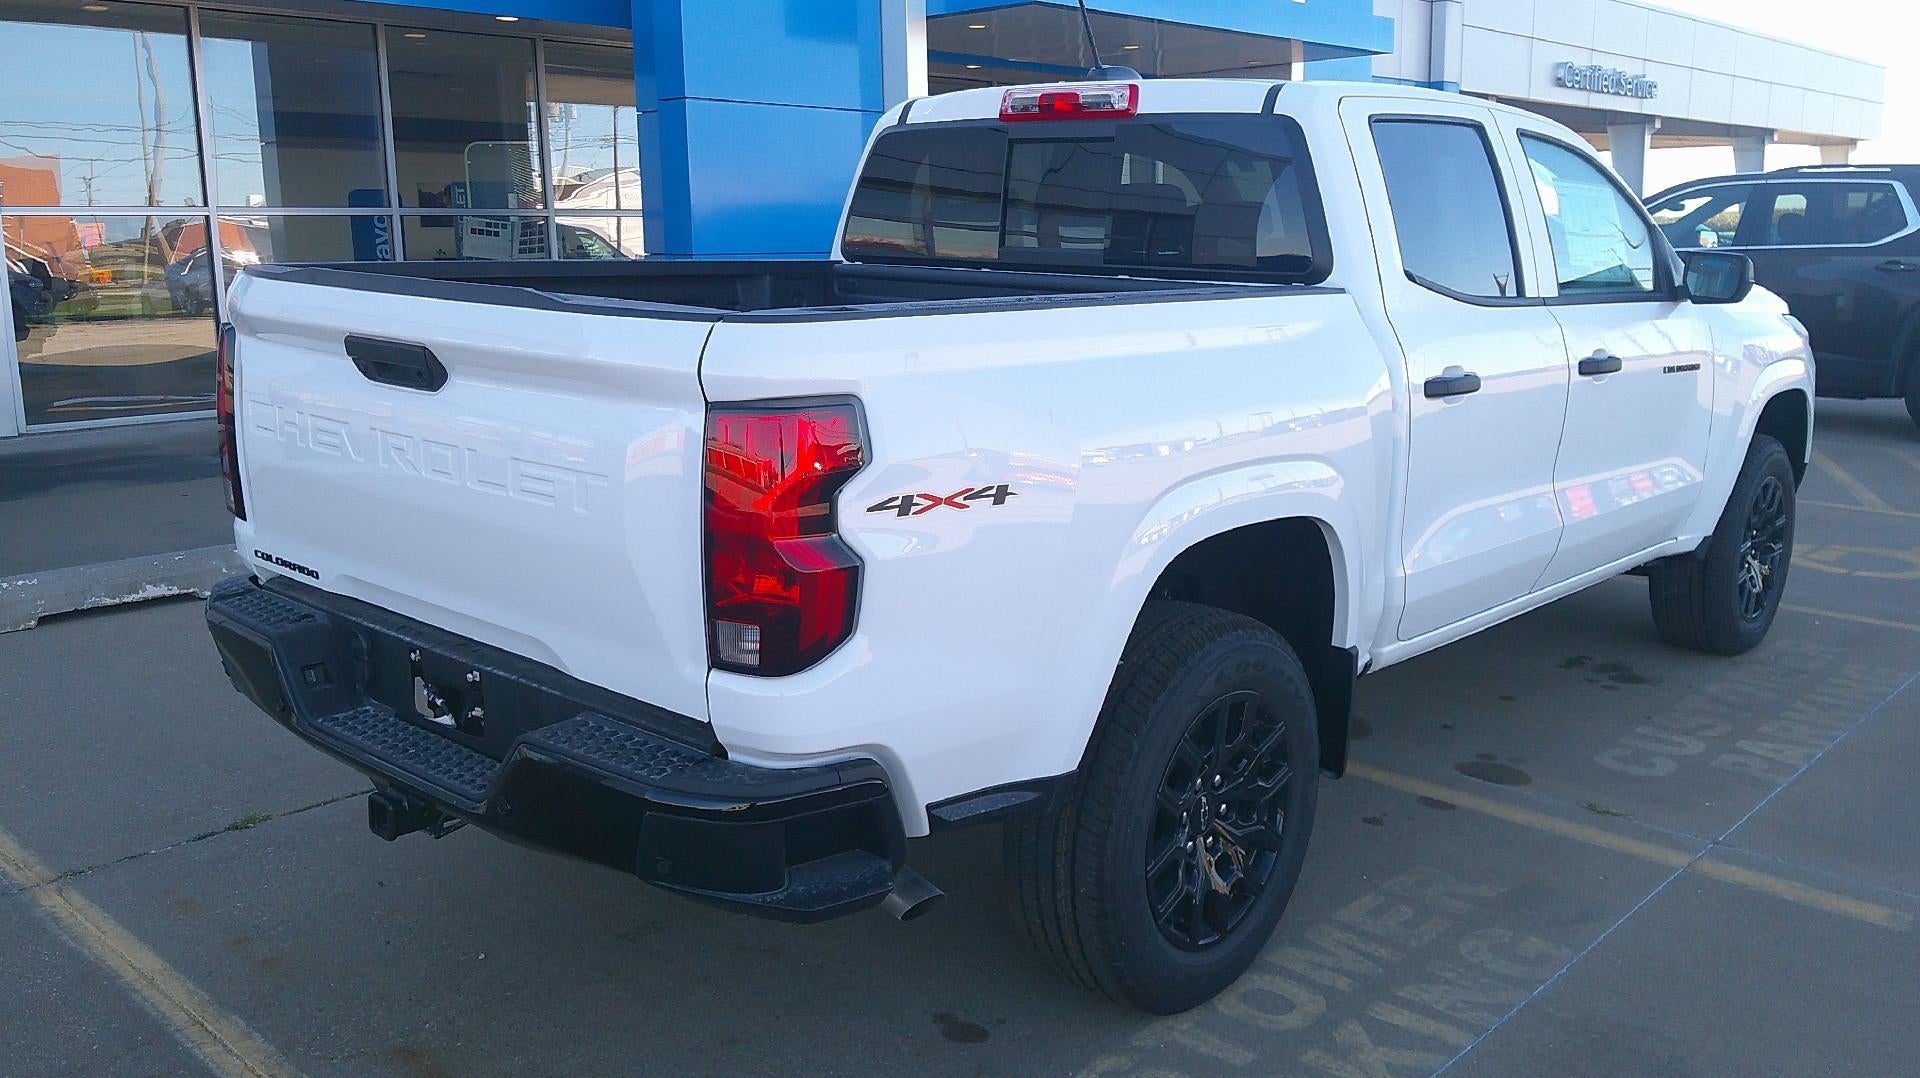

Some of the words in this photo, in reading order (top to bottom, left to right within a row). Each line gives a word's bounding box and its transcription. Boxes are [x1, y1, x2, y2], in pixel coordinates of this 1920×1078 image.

[1559, 61, 1618, 94] Certified
[1618, 71, 1659, 99] Service
[249, 399, 608, 514] CHEVROLET
[253, 548, 320, 581] COLORADO
